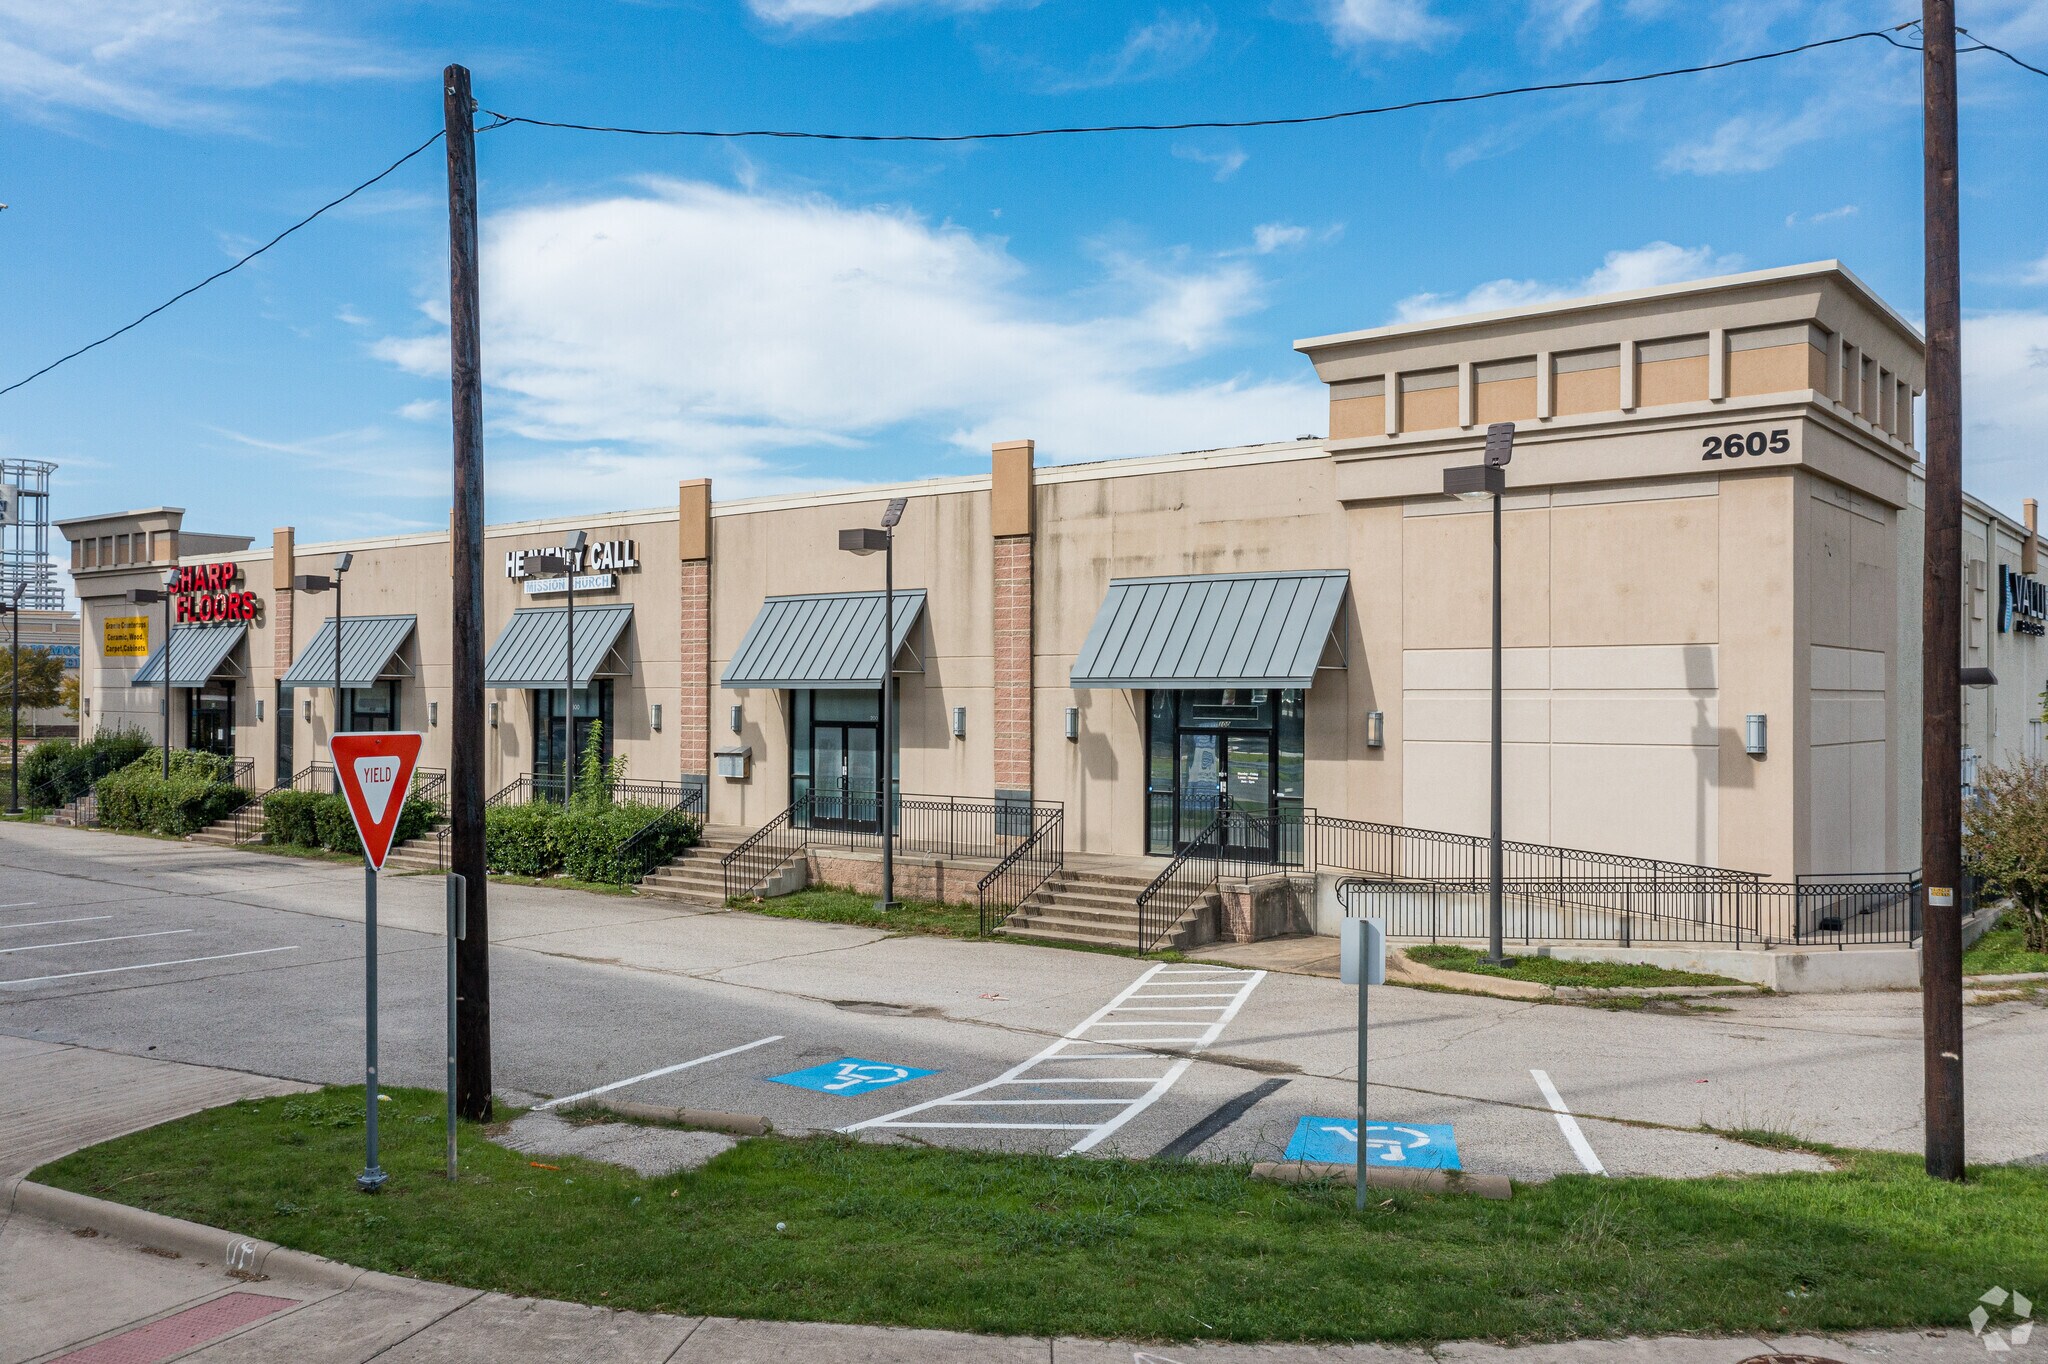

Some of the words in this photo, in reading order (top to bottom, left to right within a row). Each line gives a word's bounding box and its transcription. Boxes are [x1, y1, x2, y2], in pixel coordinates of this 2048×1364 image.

[1701, 429, 1791, 461] 2605
[505, 546, 583, 578] HELY
[591, 539, 635, 571] CALL
[572, 575, 609, 589] HURCH
[176, 591, 257, 623] FLOORS
[364, 767, 392, 783] YIELD
